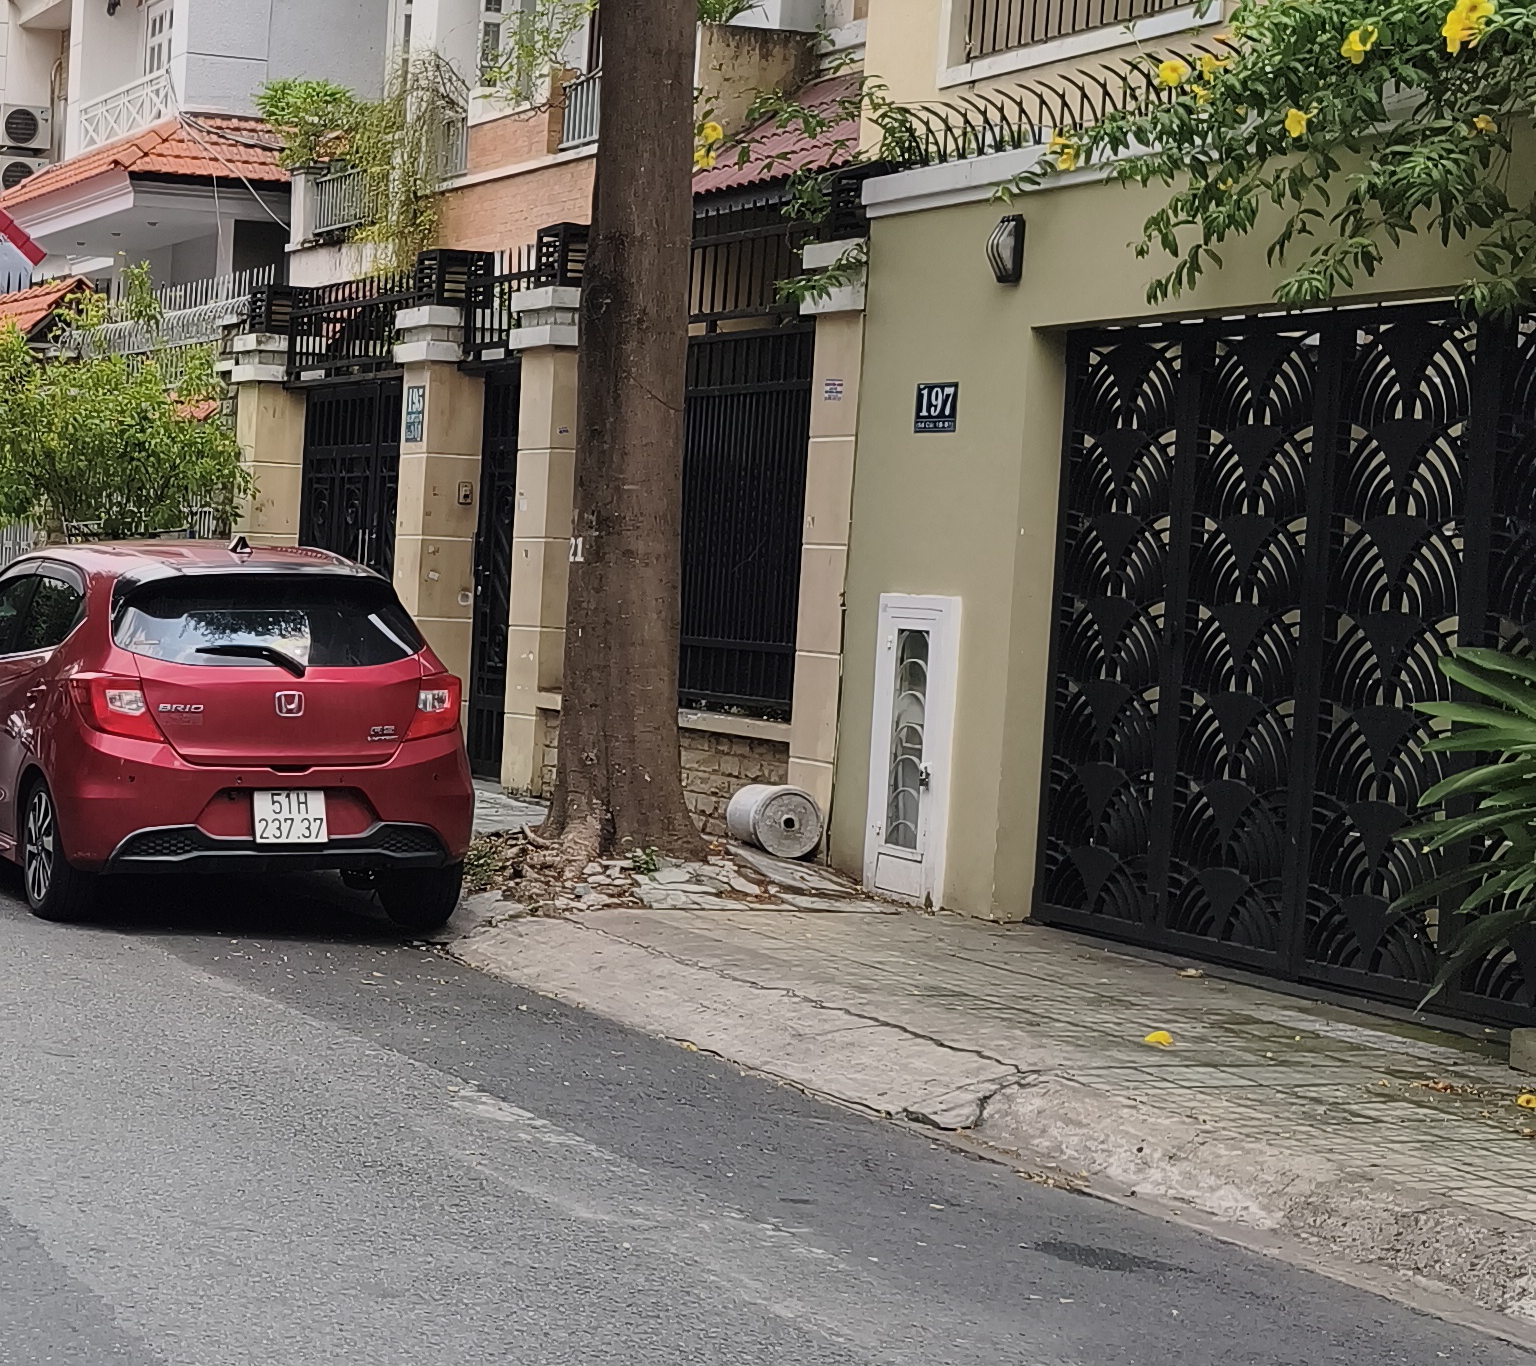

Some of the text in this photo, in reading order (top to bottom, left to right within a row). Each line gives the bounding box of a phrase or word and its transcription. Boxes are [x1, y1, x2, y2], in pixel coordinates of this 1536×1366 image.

[408, 388, 424, 412] 195
[919, 387, 955, 416] 197
[158, 704, 204, 712] BRIO
[271, 792, 309, 815] 51H
[258, 817, 324, 841] 237.37
